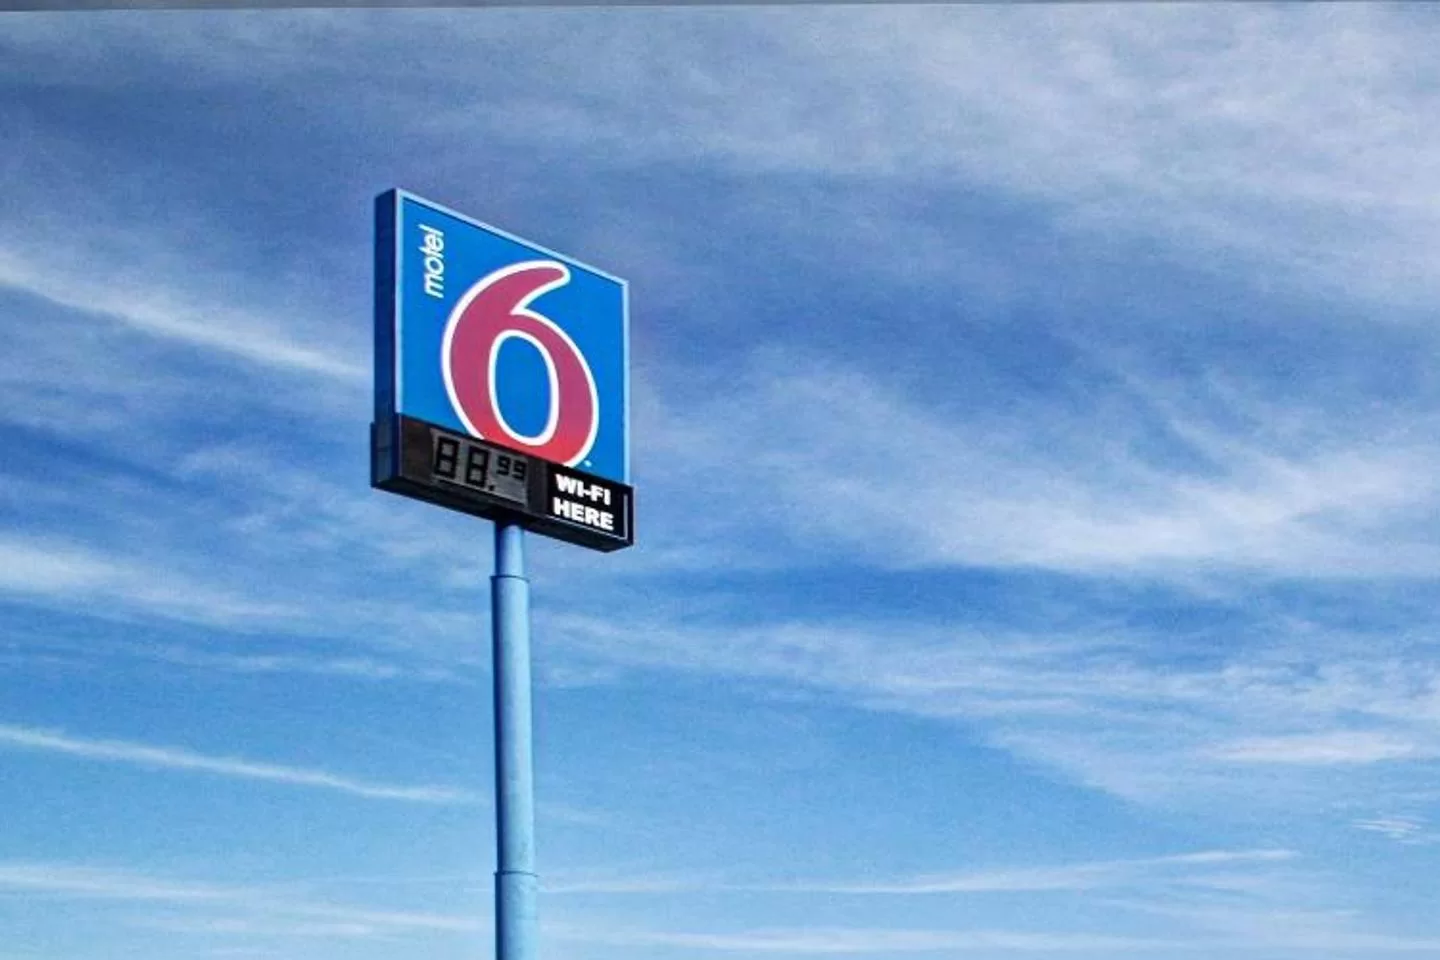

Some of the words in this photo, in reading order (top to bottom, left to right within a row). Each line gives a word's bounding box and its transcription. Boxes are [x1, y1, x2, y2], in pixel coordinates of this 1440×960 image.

[418, 223, 445, 300] motel
[440, 259, 600, 468] 6
[553, 496, 615, 532] HERE
[555, 473, 612, 506] WI-FI
